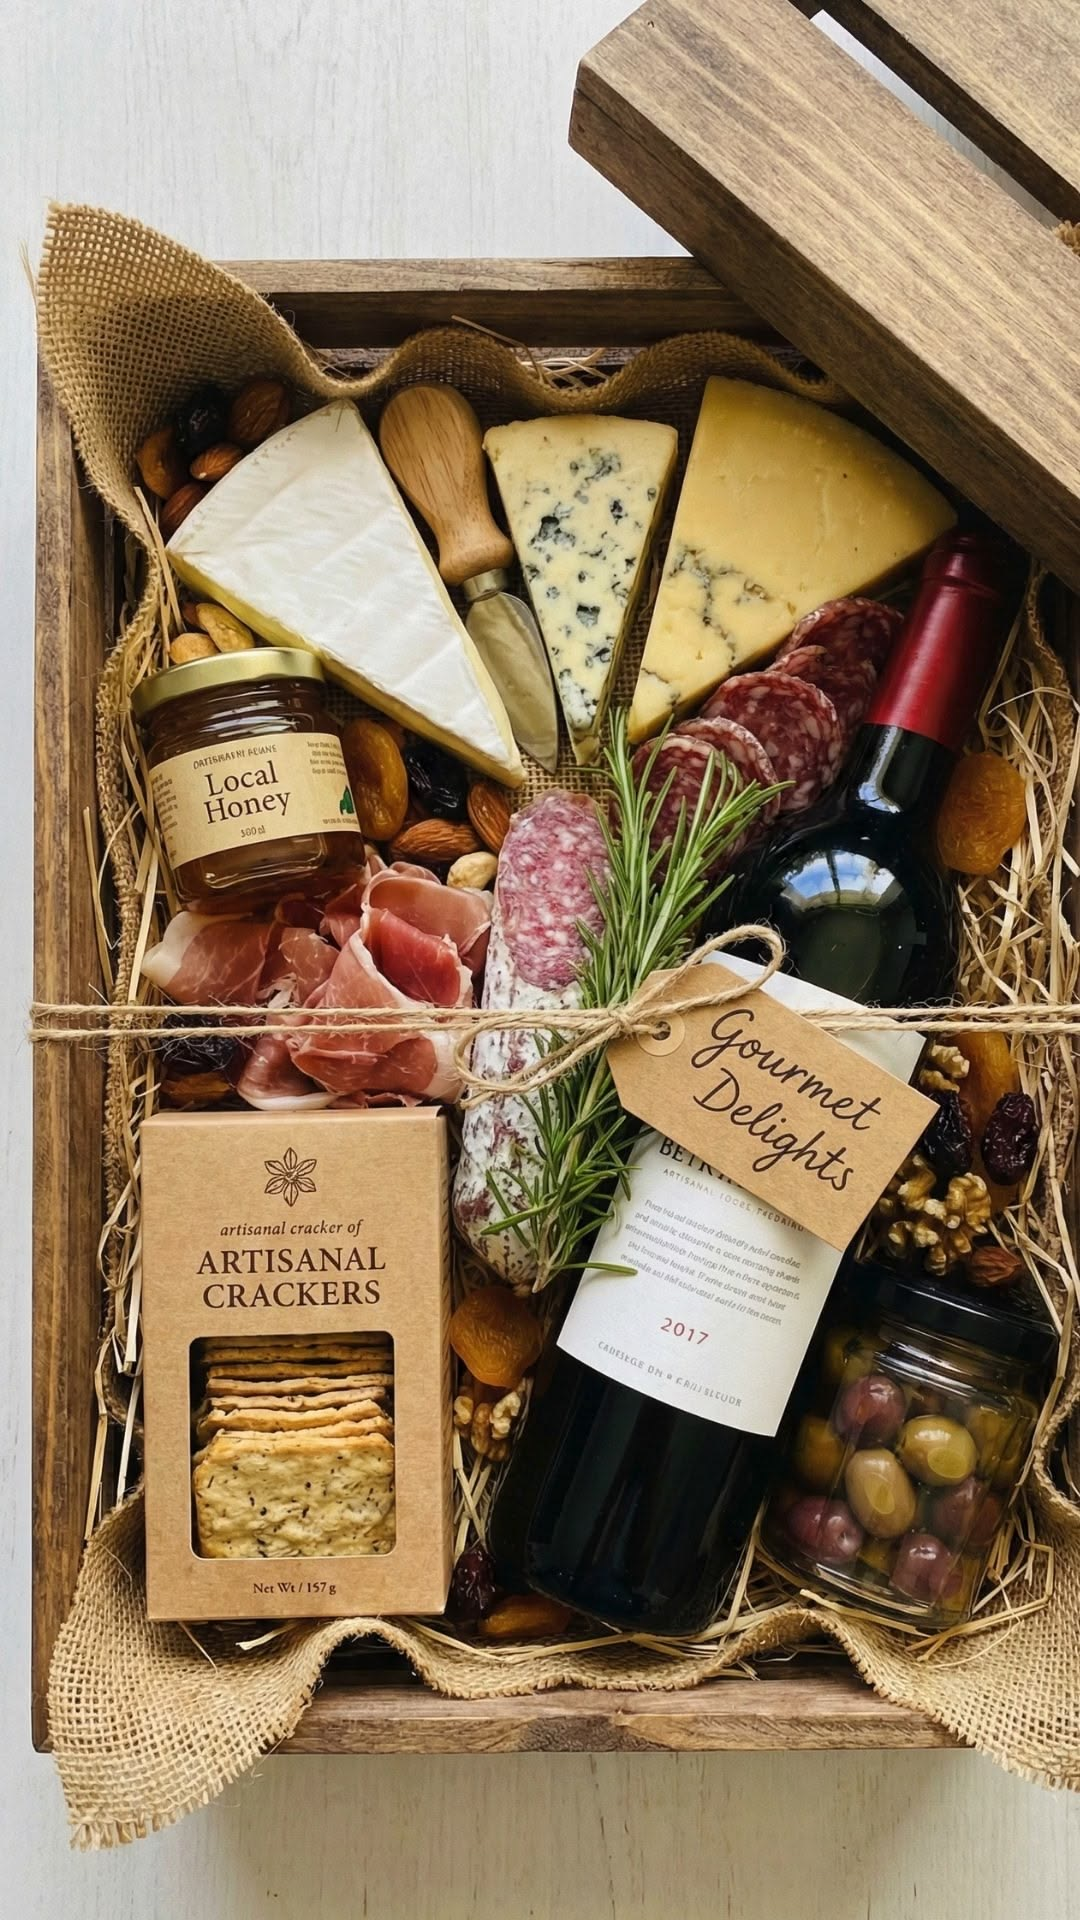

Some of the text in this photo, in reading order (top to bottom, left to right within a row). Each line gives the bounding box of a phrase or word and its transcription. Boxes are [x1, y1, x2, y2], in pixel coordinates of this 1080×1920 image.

[204, 760, 279, 797] Local
[203, 792, 291, 824] Honey
[691, 1008, 881, 1130] Gourmet
[693, 1067, 854, 1191] Delights
[220, 1219, 364, 1237] artisanal cracker of
[196, 1247, 386, 1275] ARTISANAL
[203, 1280, 381, 1309] CRACKERS
[660, 1317, 709, 1345] 2017
[253, 1583, 274, 1594] Net
[277, 1582, 295, 1593] Wt
